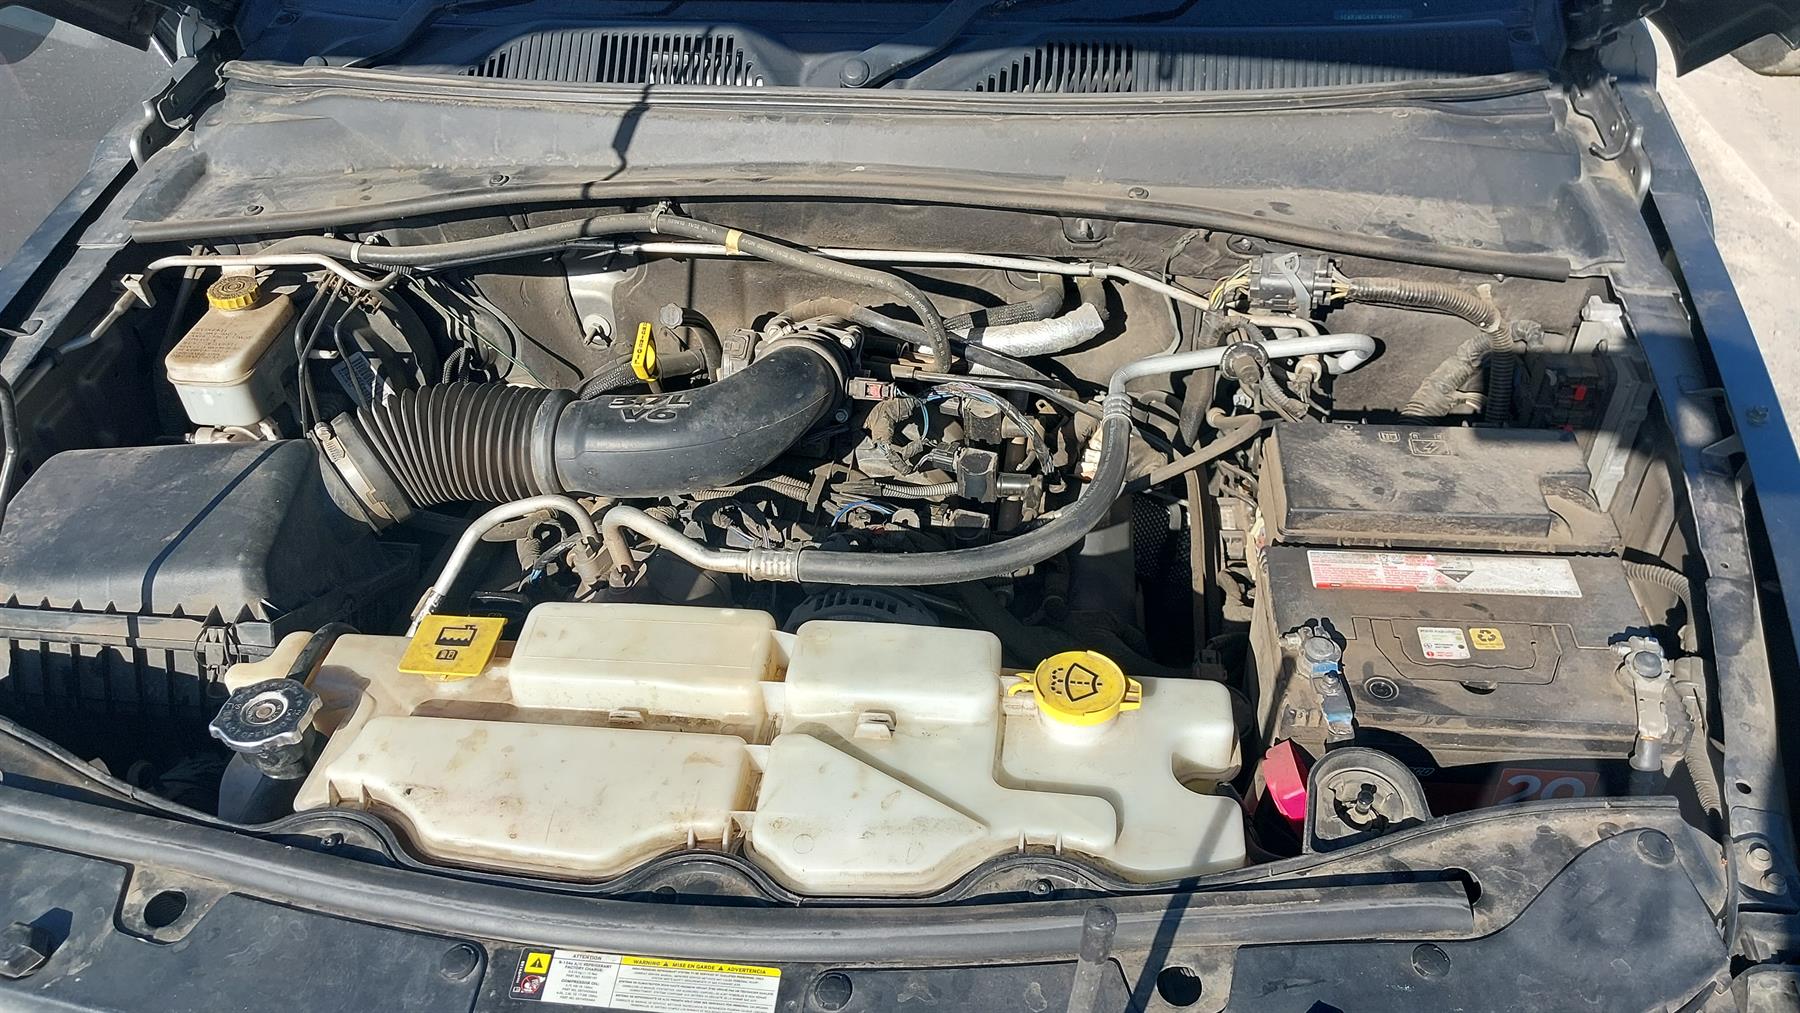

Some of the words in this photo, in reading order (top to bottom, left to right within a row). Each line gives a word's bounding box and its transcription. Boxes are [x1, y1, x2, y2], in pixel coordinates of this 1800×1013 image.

[904, 290, 915, 300] DOT
[916, 300, 929, 313] AVON
[621, 408, 678, 423] V6
[1503, 775, 1586, 803] 20
[727, 966, 766, 974] ADVERTENCIA
